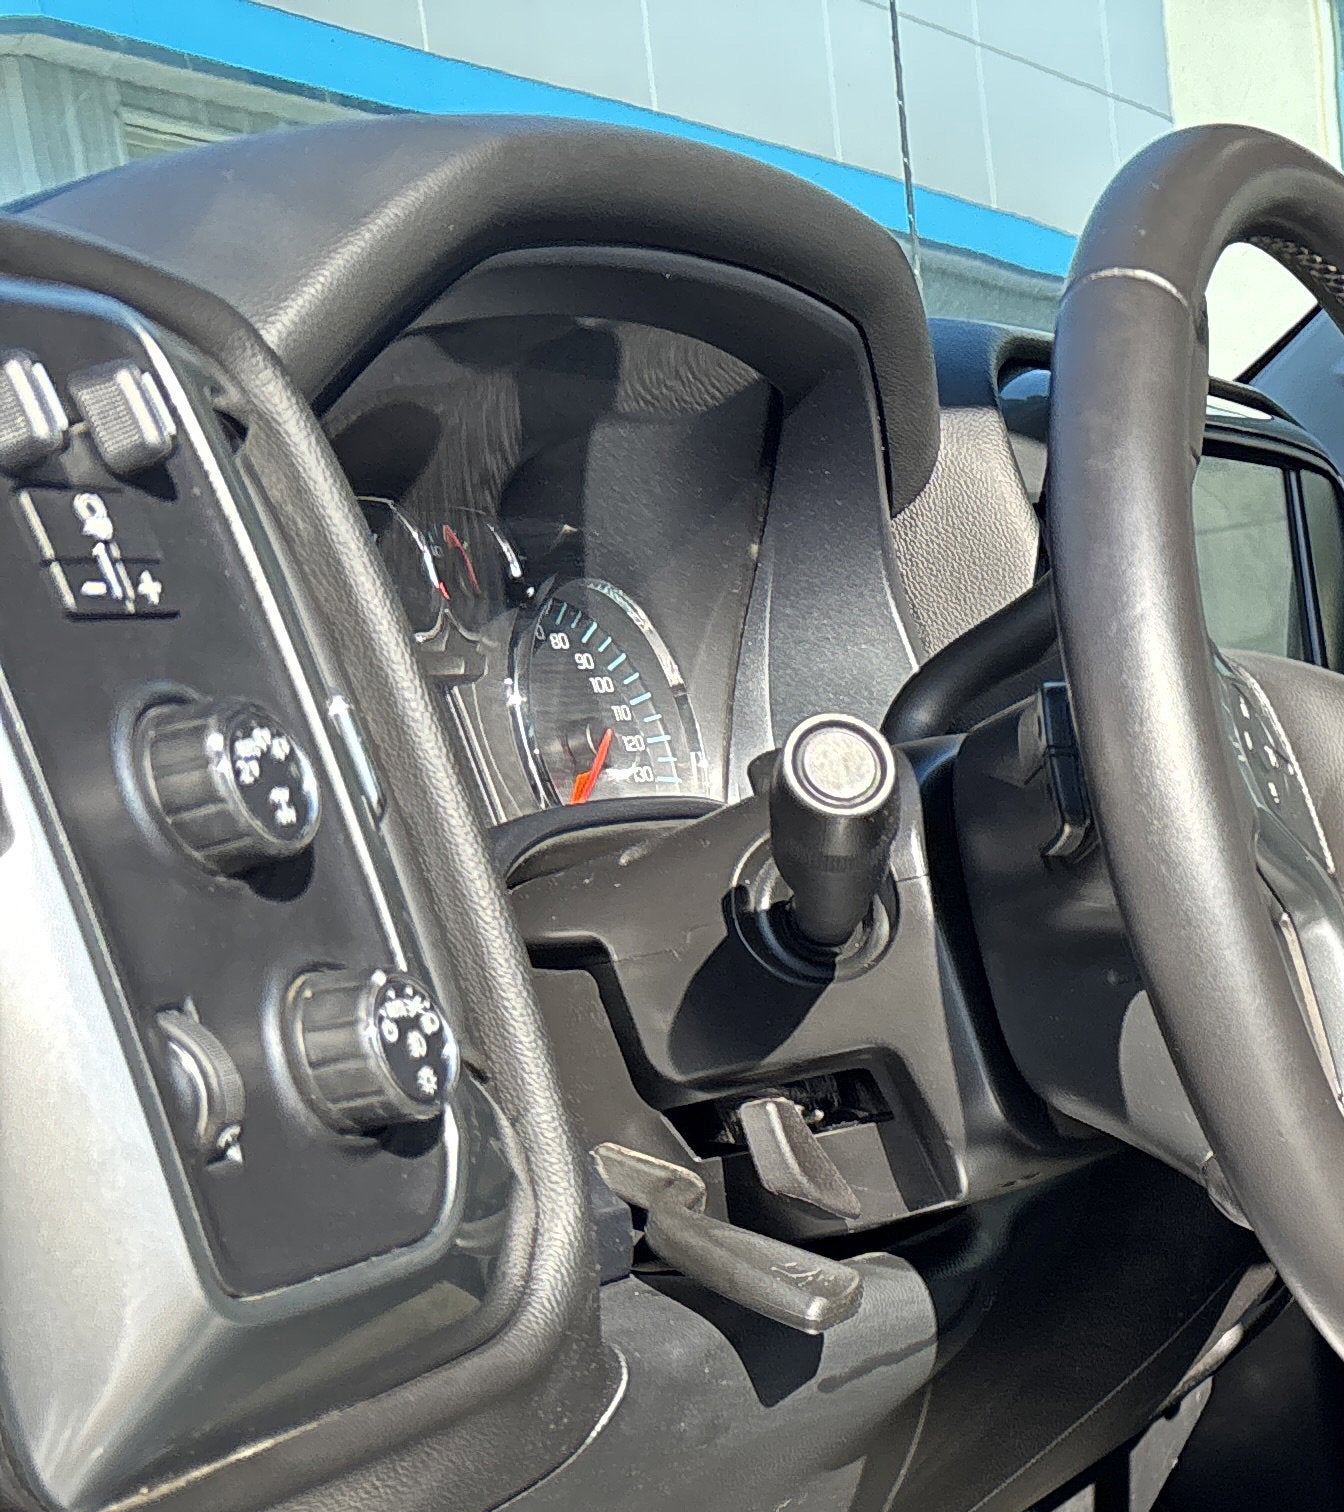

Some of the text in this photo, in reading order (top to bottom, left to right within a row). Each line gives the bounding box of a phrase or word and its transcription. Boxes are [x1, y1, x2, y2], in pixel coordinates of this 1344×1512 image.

[549, 632, 570, 650] 80
[574, 652, 595, 670] 90
[589, 676, 614, 693] 100
[610, 704, 632, 721] 110
[621, 734, 646, 752] 120
